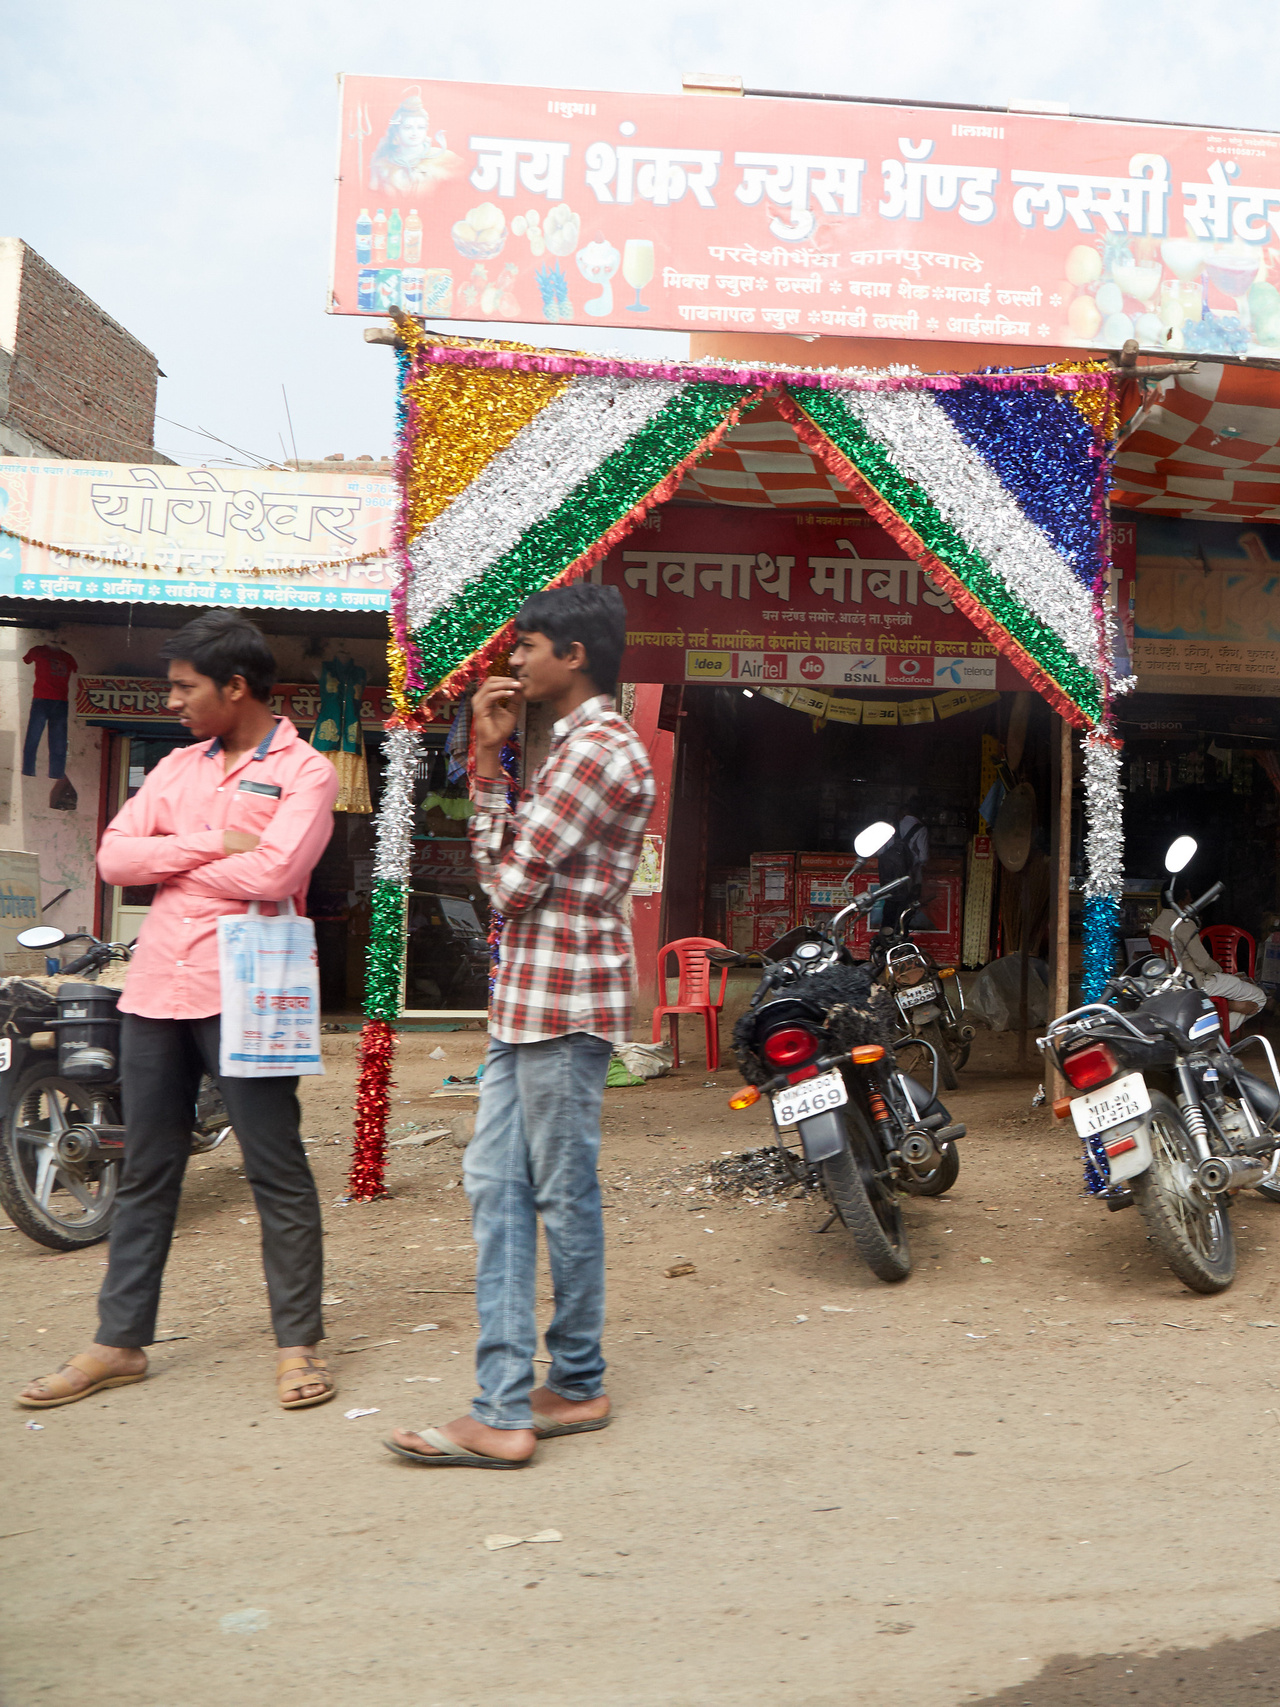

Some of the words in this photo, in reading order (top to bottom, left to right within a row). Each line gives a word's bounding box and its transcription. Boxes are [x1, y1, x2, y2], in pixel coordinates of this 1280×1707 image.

[468, 136, 571, 200] जय
[585, 120, 722, 209] शंकर
[733, 150, 866, 242] ज्युस
[1010, 152, 1172, 236] लस्सी
[849, 249, 984, 274] कानपुरवाले
[662, 267, 710, 291] मिक्स
[774, 272, 822, 295] लस्सी
[848, 280, 892, 299] बदाम
[897, 277, 930, 301] शेक
[944, 283, 992, 306] मलाई
[995, 285, 1042, 308] लस्सी
[819, 305, 867, 331] घमंडी
[872, 310, 919, 332] लस्सी
[91, 467, 361, 545] योगेश्वर
[621, 550, 797, 602] नवनाथ
[687, 627, 709, 649] सर्व
[711, 628, 766, 651] नामांकित
[767, 629, 813, 652] कंपनीचे
[864, 638, 875, 653] व
[934, 640, 968, 657] करून
[740, 660, 784, 679] Airtel
[801, 662, 823, 674] Jio
[844, 672, 881, 684] BSNL
[886, 675, 933, 685] vodafone
[962, 667, 995, 678] telenor
[806, 697, 824, 710] 3G
[879, 709, 895, 719] 3G
[951, 695, 968, 708] 3G
[780, 1087, 842, 1122] 8469
